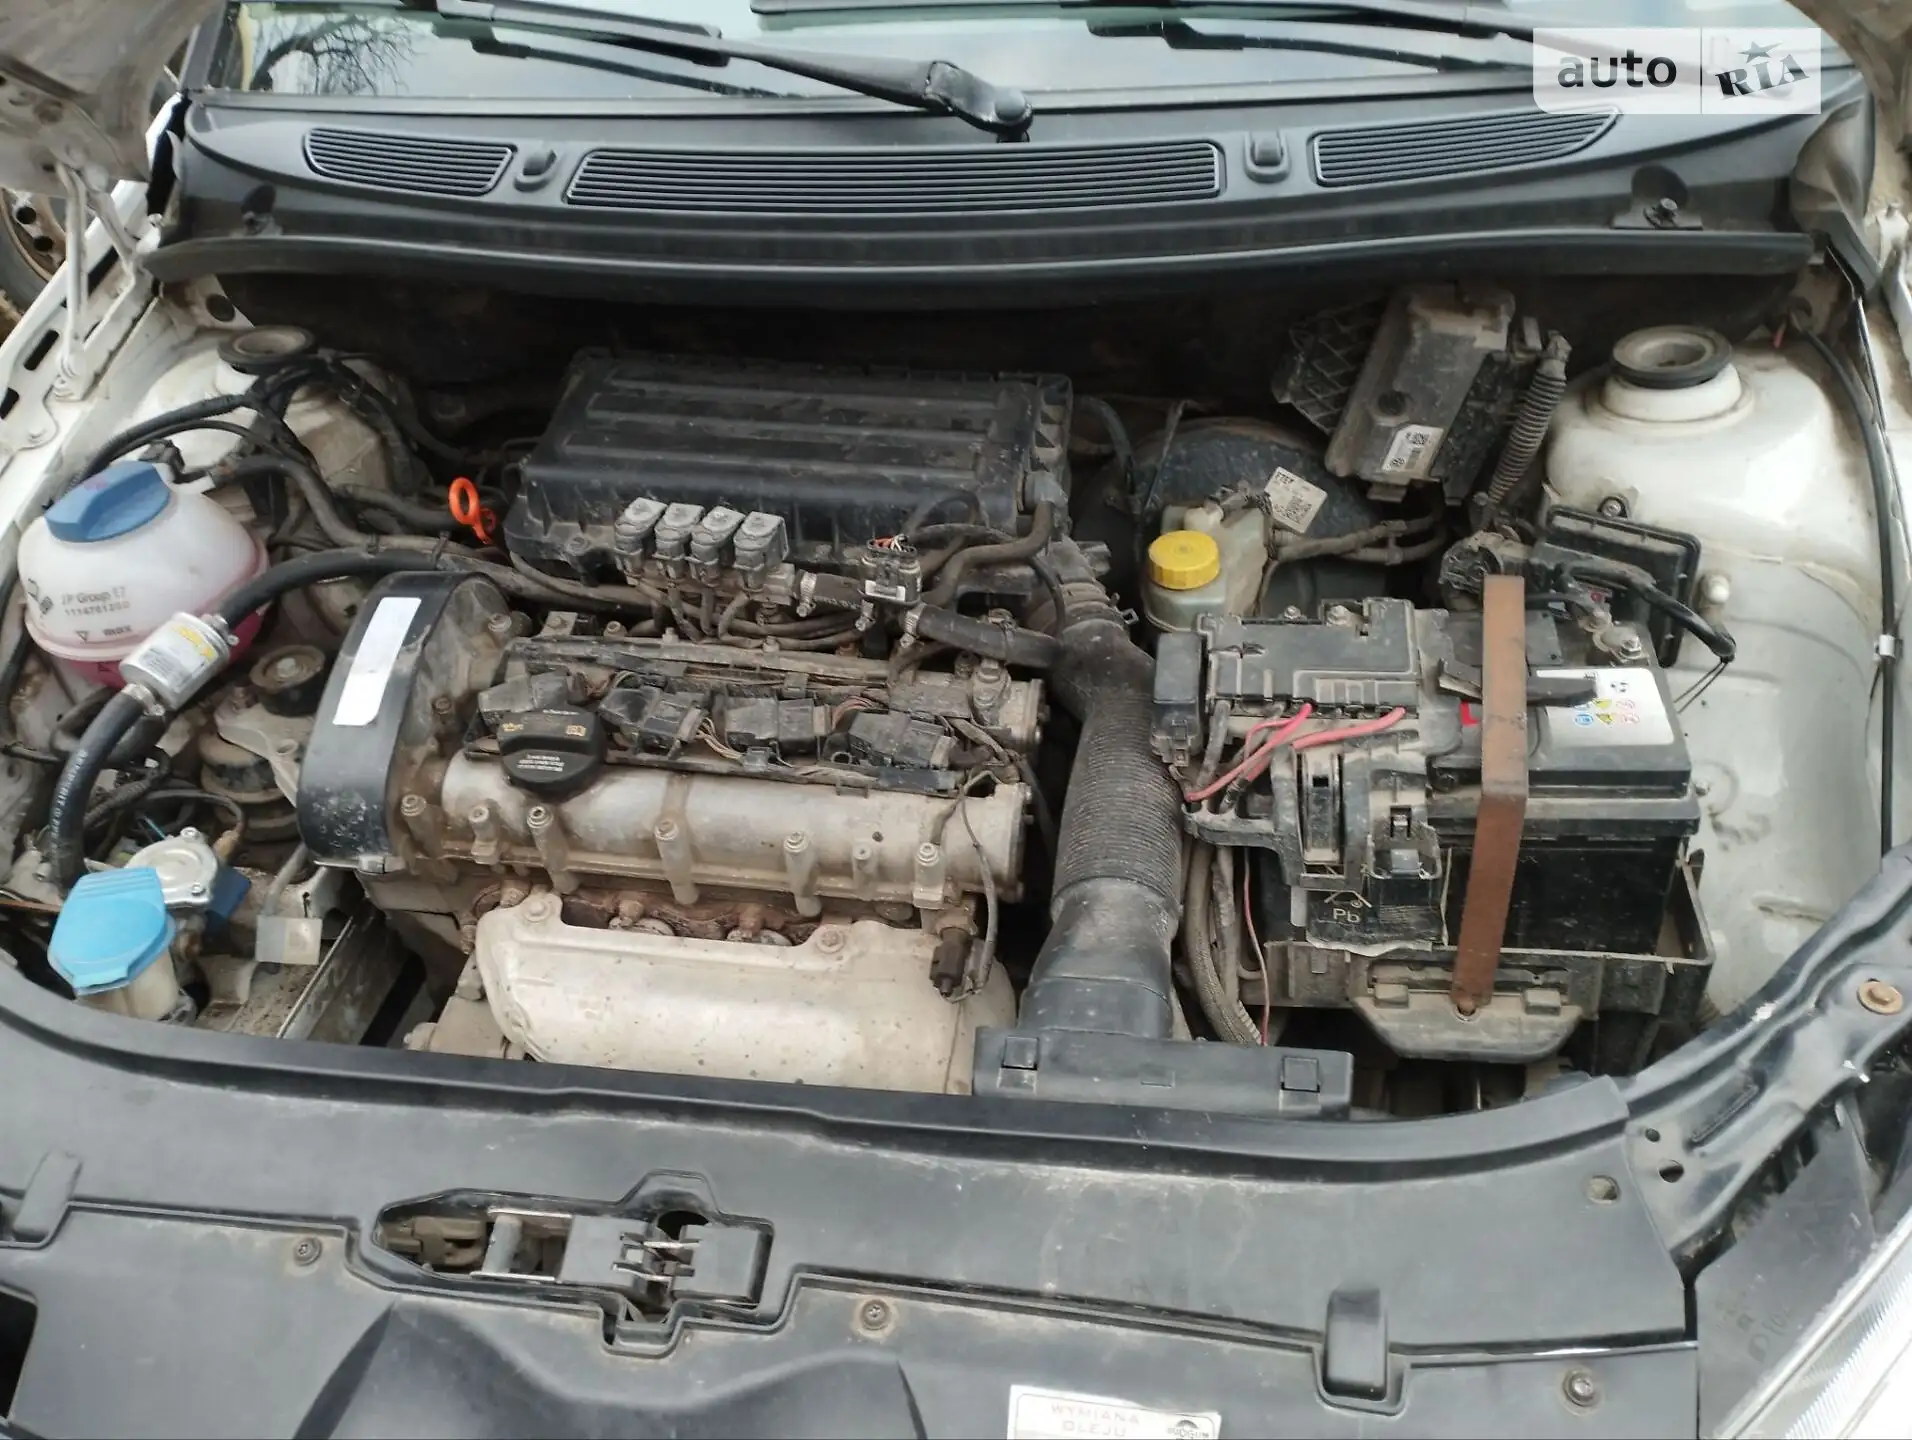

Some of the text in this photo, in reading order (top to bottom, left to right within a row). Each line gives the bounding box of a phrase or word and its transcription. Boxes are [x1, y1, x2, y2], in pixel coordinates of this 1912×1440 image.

[1332, 907, 1362, 923] Pb
[1051, 1403, 1139, 1424] WYMIANA
[1062, 1419, 1127, 1437] OLEJU
